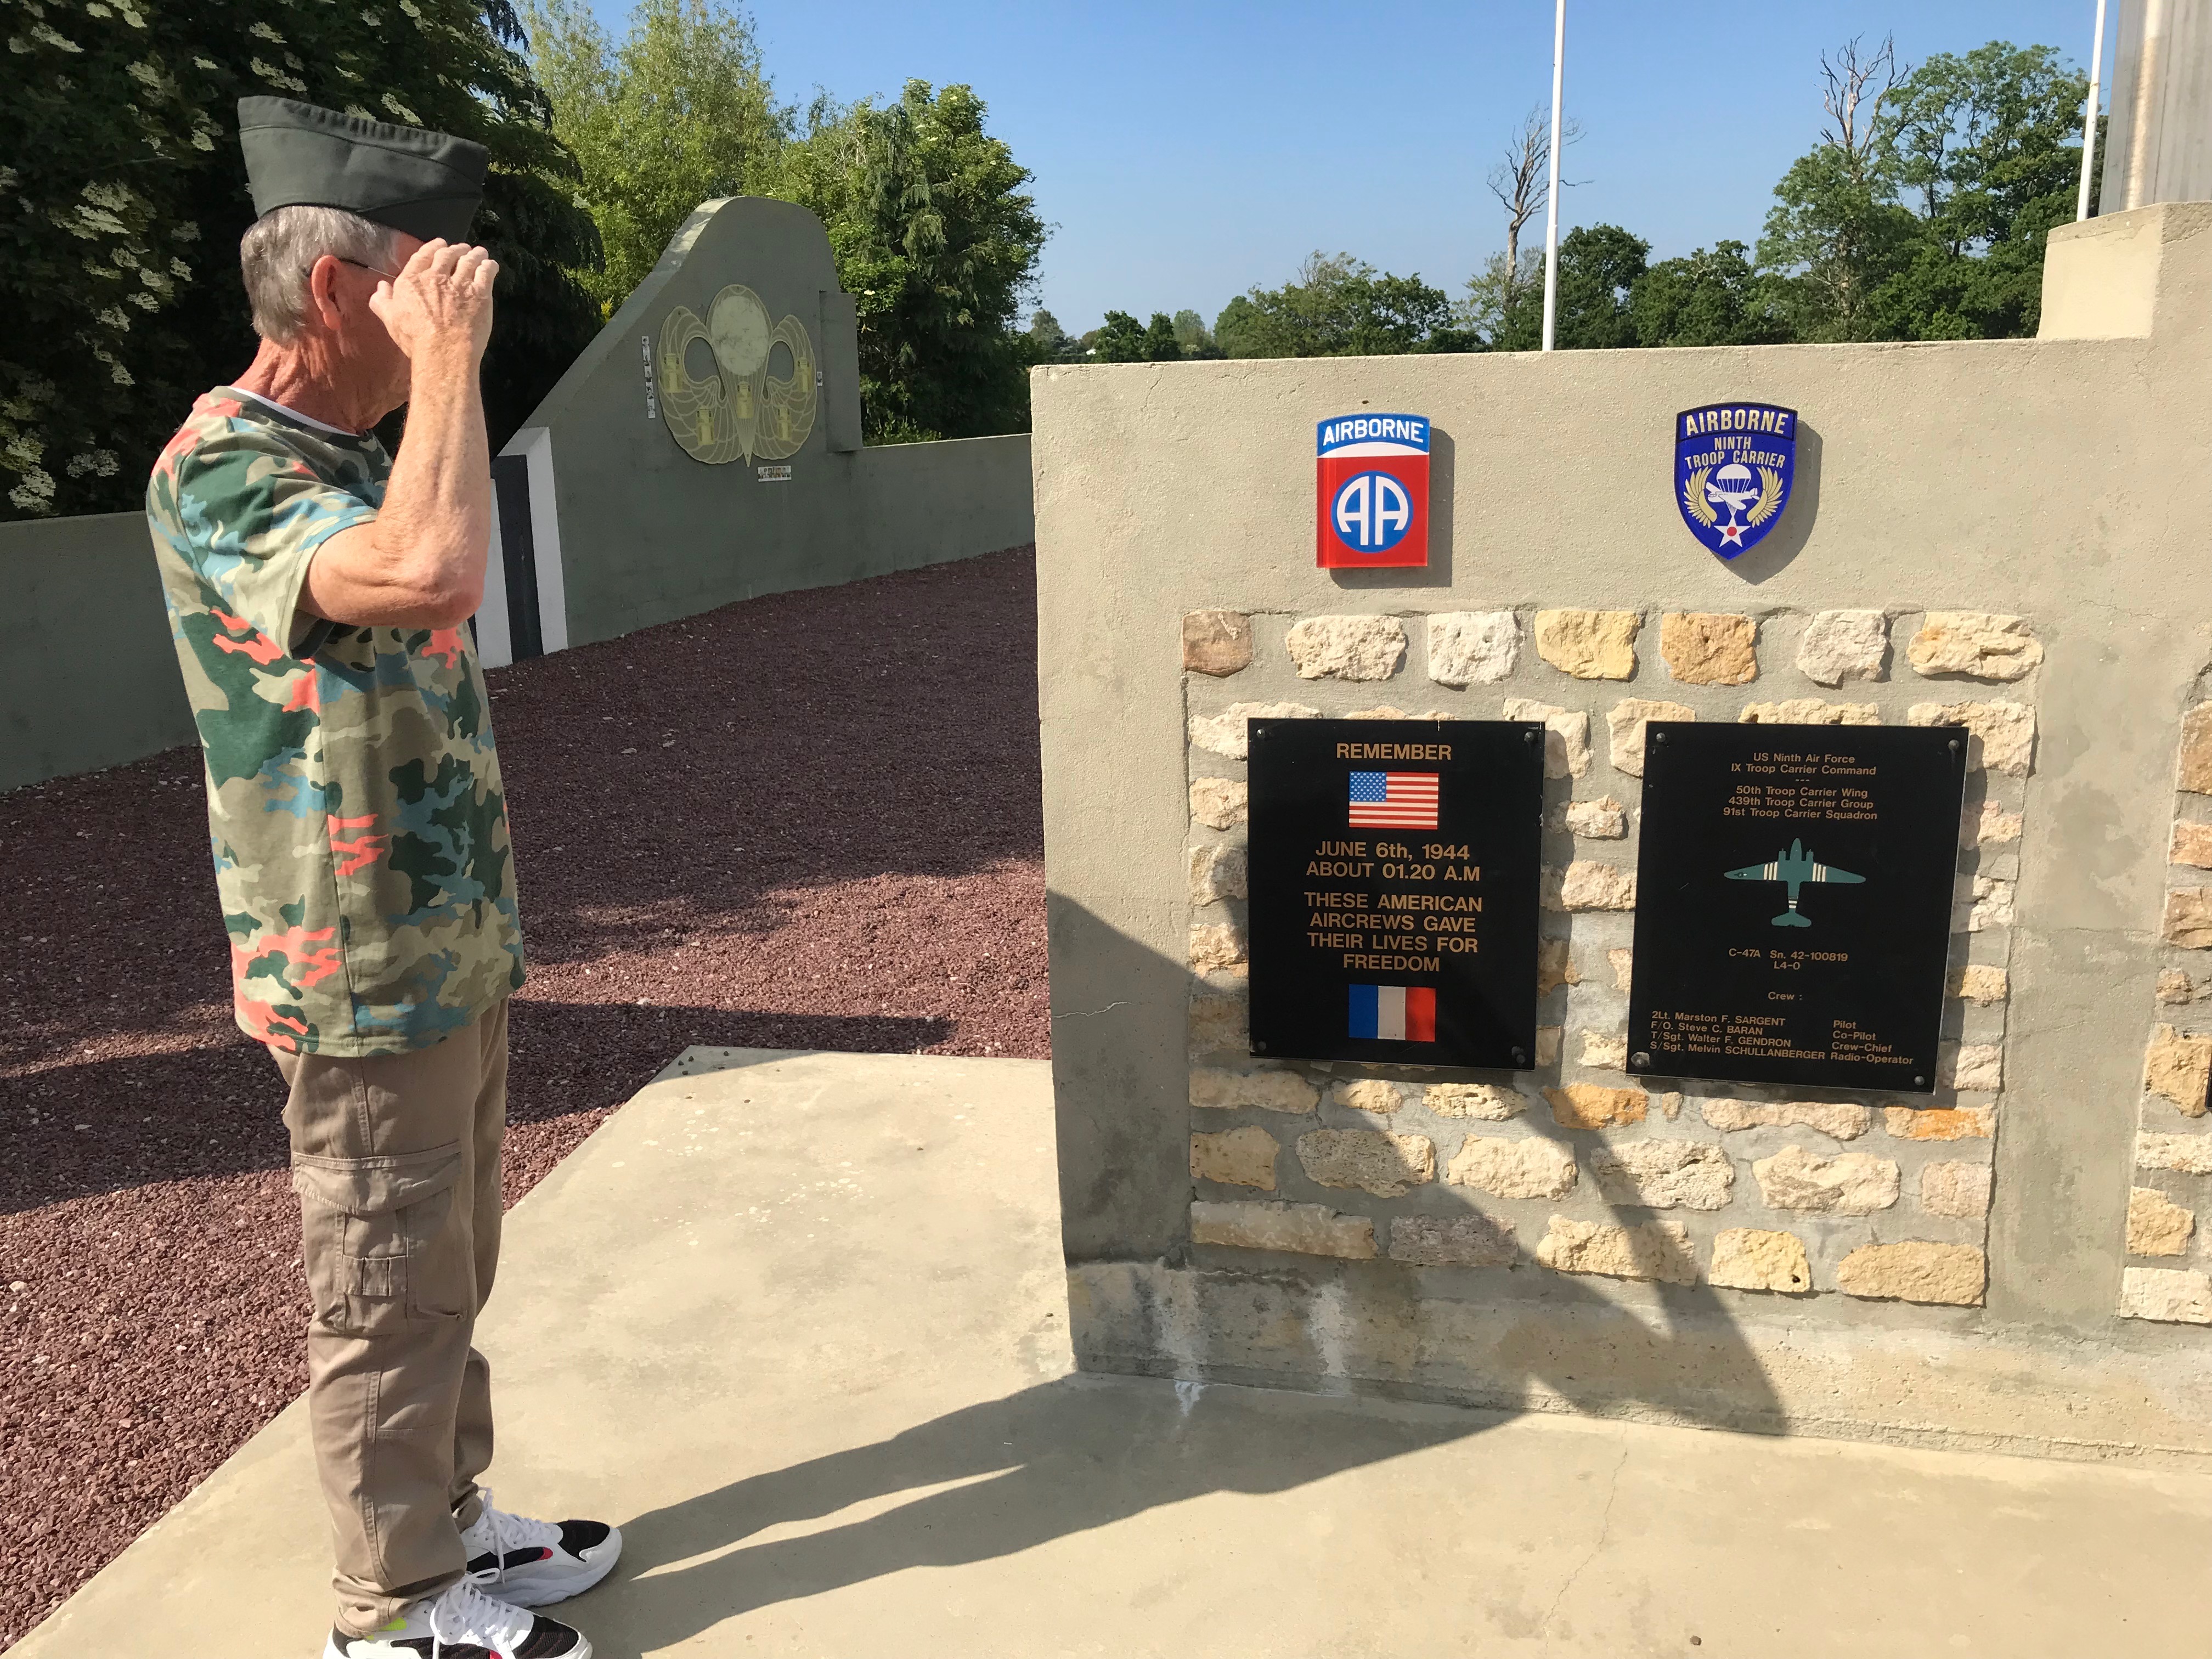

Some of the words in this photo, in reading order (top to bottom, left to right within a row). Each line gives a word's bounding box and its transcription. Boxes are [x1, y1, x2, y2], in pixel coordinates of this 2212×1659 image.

[1686, 409, 1788, 436] AIRBORNE
[1323, 419, 1424, 445] AIRBORNE
[1714, 437, 1752, 450] NINTH
[1684, 452, 1725, 469] TROOP
[1733, 450, 1786, 468] CARRIER
[1336, 475, 1408, 546] AA
[1337, 743, 1451, 760] REMEMBER
[1754, 753, 1768, 761] US
[1774, 753, 1801, 761] Ninth
[1825, 754, 1855, 763] Force
[1731, 763, 1741, 771] IX
[1746, 764, 1775, 774] Troop
[1780, 764, 1817, 774] Carrier
[1822, 765, 1876, 775] Command
[1736, 786, 1760, 794] 50th
[1766, 786, 1795, 797] Troop
[1801, 787, 1837, 796] Carrier
[1842, 788, 1867, 799] Wing
[1729, 797, 1760, 805] 439th
[1765, 797, 1795, 808] Troop
[1800, 798, 1836, 807] Carrier
[1841, 799, 1873, 810] Group
[1724, 807, 1745, 816] 91st
[1750, 808, 1779, 818] Troop
[1785, 809, 1821, 817] Carrier
[1826, 810, 1877, 820] Squadron
[1316, 841, 1366, 857] JUNE
[1376, 842, 1412, 861] 6th,
[1422, 844, 1470, 860] 1944
[1306, 861, 1374, 877] ABOUT
[1383, 864, 1435, 879] 01.20
[1444, 866, 1480, 881] A.M
[1304, 892, 1368, 908] THESE
[1378, 895, 1482, 912] AMERICAN
[1310, 913, 1414, 930] AIRCREWS
[1424, 916, 1475, 932] GAVE
[1307, 933, 1363, 948] THEIR
[1373, 935, 1427, 951] LIVES
[1437, 937, 1477, 952] FOR
[1344, 954, 1439, 971] FREEDOM
[1729, 949, 1760, 957] C-47A
[1770, 950, 1786, 958] Sn.
[1791, 951, 1848, 961] 42-100819
[1652, 1011, 1670, 1019] 2Lt.
[1675, 1012, 1717, 1022] Marston
[1735, 1016, 1785, 1026] SARGENT
[1833, 1020, 1856, 1029] Pilot
[1678, 1023, 1707, 1031] Steve
[1727, 1026, 1763, 1035] BARAN
[1833, 1030, 1876, 1040] Co-Pilot
[1688, 1034, 1720, 1042] Walter
[1739, 1036, 1791, 1047] GENDRON
[1832, 1042, 1892, 1052] Crew-Chief
[1688, 1044, 1720, 1053] Melvin
[1725, 1046, 1825, 1059] SCHULLANBERGER
[1831, 1052, 1914, 1064] Radio-Operator
